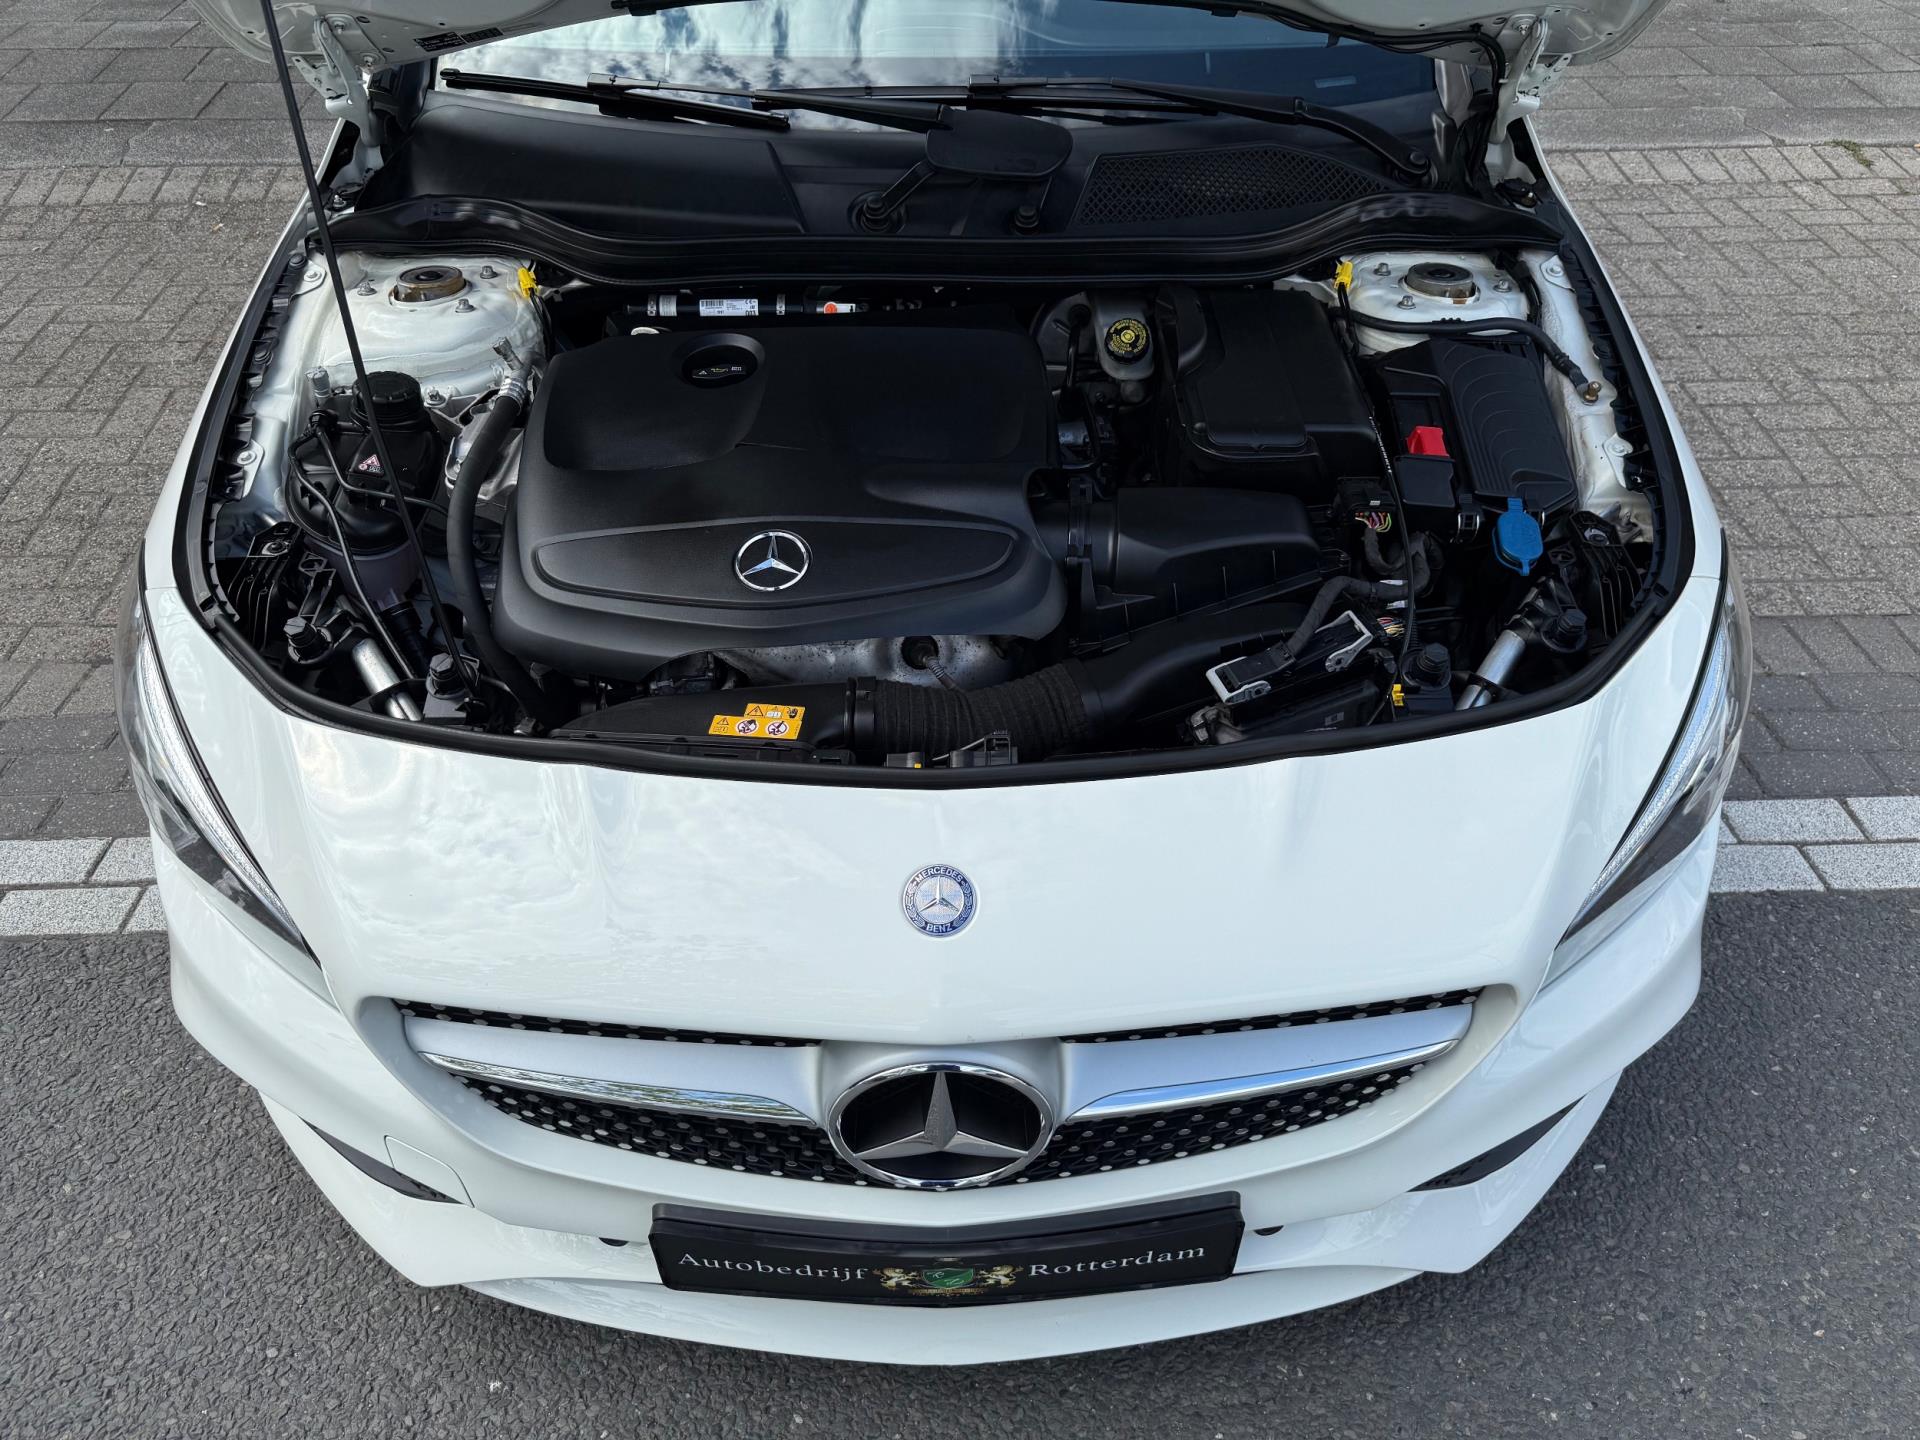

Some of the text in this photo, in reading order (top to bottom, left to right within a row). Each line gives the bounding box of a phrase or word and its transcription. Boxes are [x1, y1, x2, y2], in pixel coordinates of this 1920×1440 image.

[915, 866, 964, 883] MERCEDES
[926, 923, 953, 933] BENZ
[678, 1247, 1205, 1281] Autobedrijf Rotterdam
